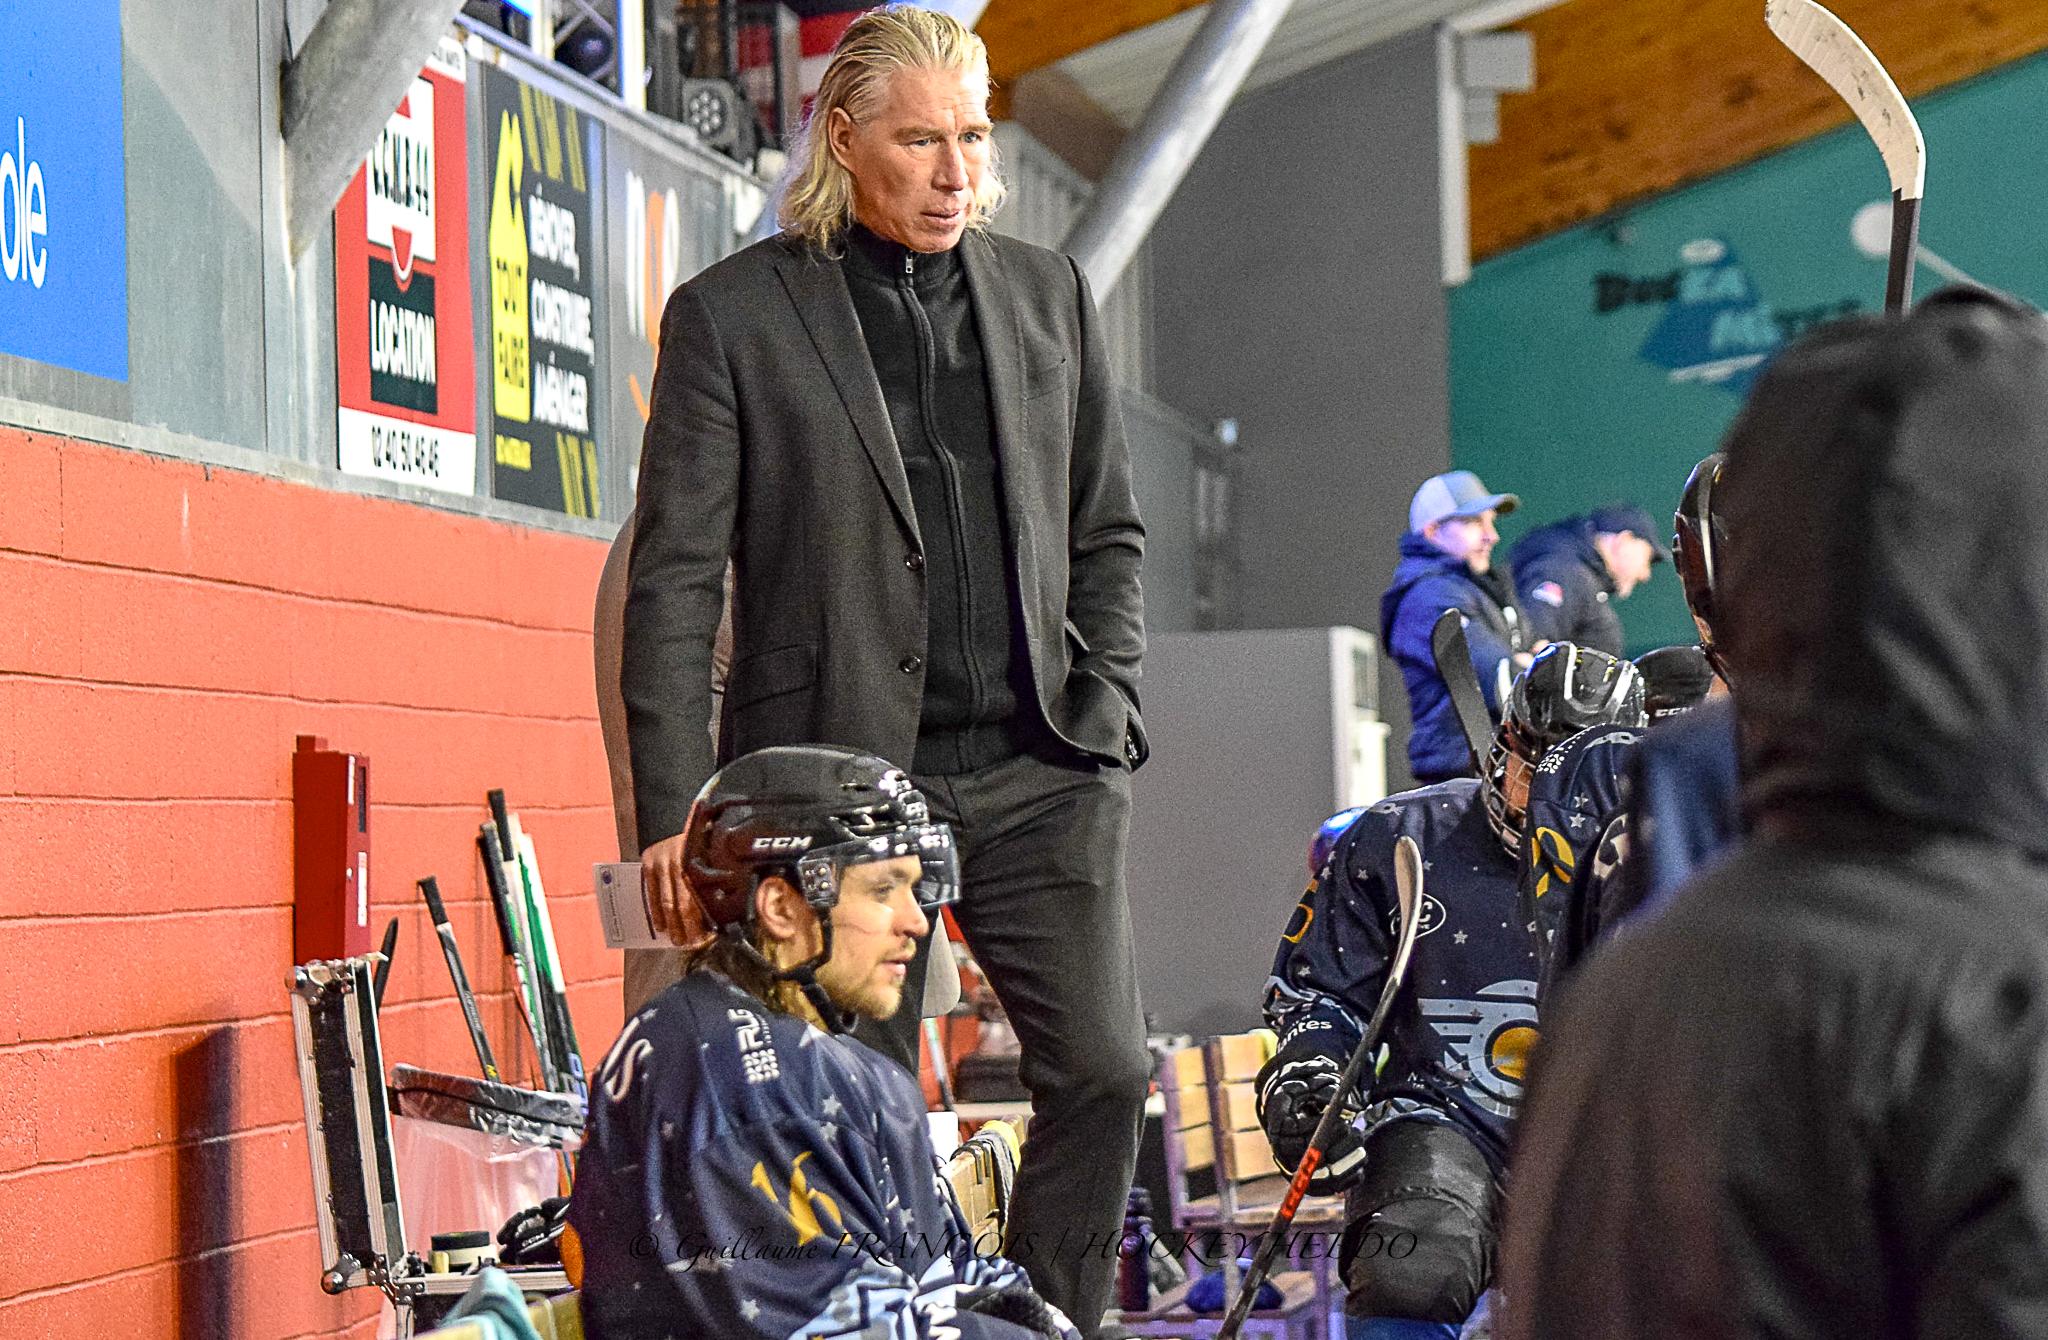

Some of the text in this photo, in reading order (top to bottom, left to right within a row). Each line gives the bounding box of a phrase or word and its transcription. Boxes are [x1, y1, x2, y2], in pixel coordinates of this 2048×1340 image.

[496, 257, 522, 313] TOUT
[370, 299, 436, 384] LOCATION
[498, 332, 525, 389] FAIRE
[385, 428, 398, 470] 40
[752, 836, 812, 850] CCM
[1277, 1019, 1333, 1054] antes
